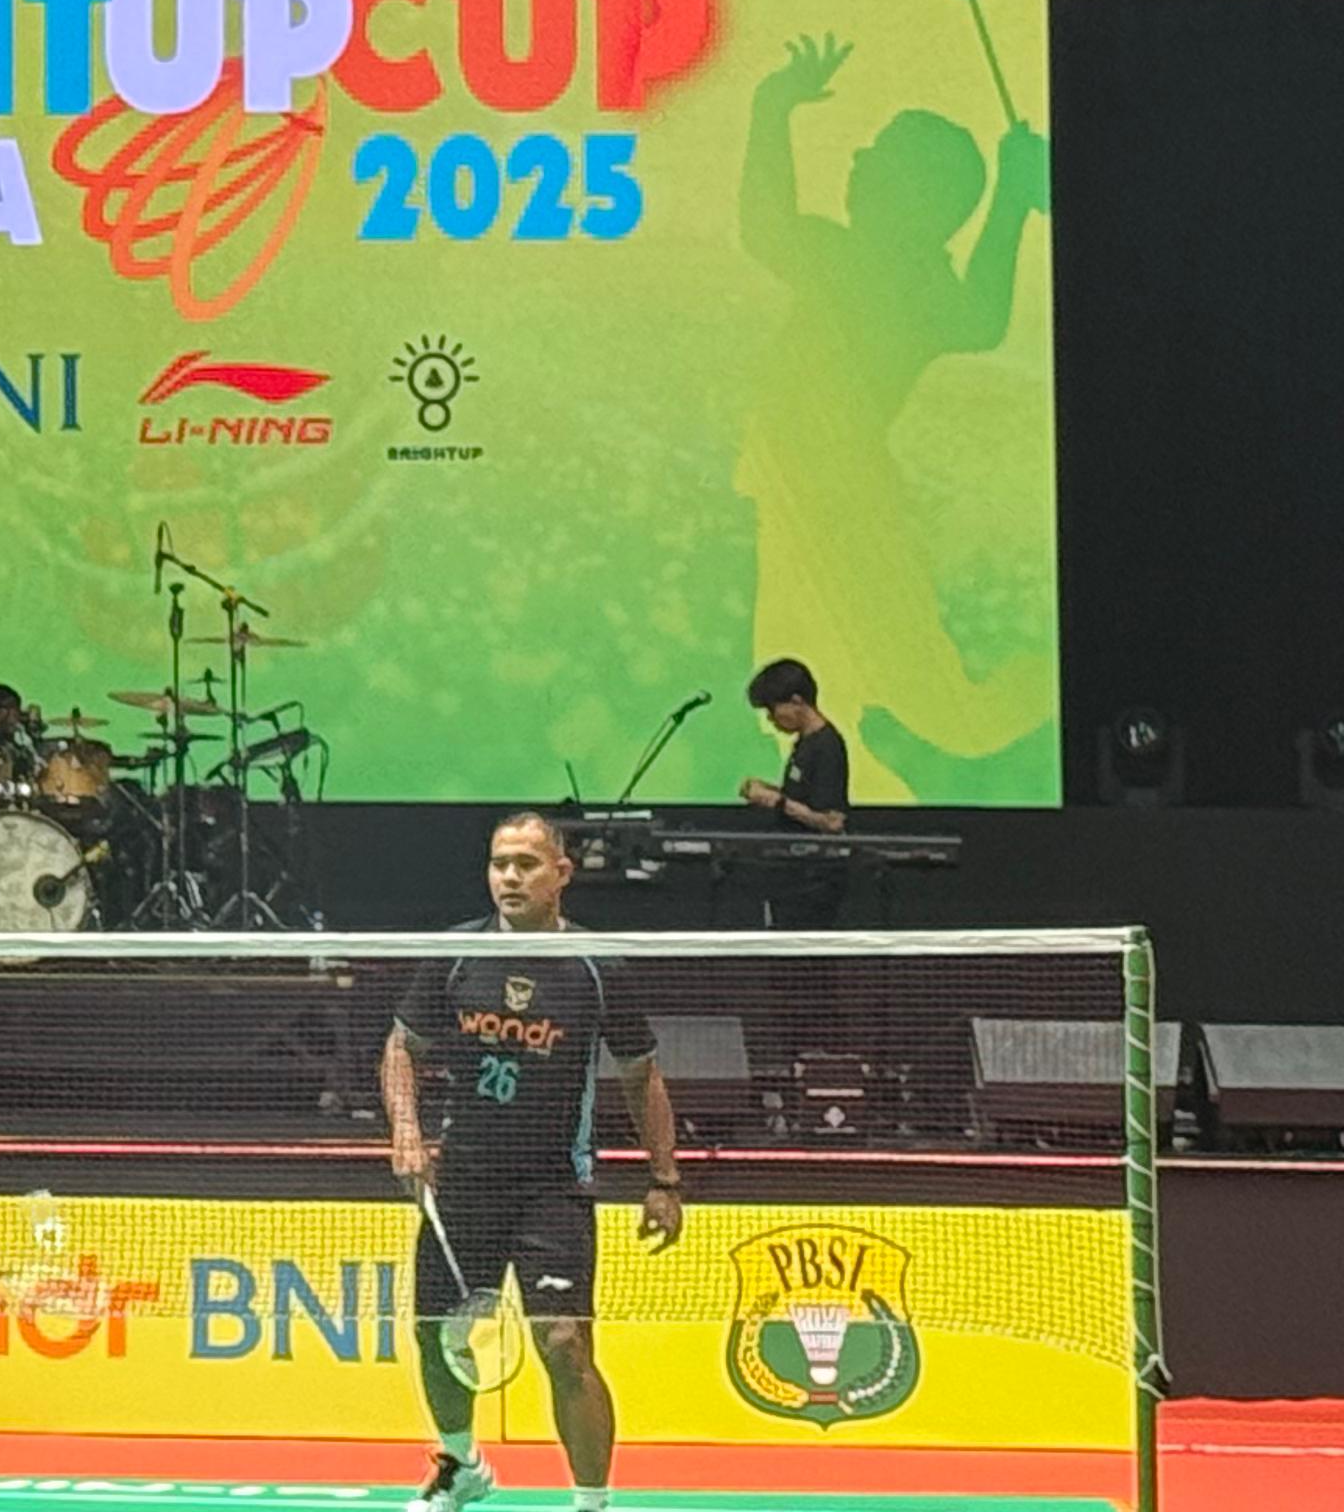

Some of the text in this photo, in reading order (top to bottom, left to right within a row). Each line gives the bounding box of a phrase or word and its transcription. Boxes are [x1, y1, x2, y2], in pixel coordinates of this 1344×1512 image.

[352, 134, 645, 240] 2025
[139, 417, 333, 444] LI-NING
[458, 1009, 564, 1047] wondr
[477, 1054, 519, 1104] 26
[768, 1237, 869, 1292] PBSI
[189, 1259, 398, 1362] BNI
